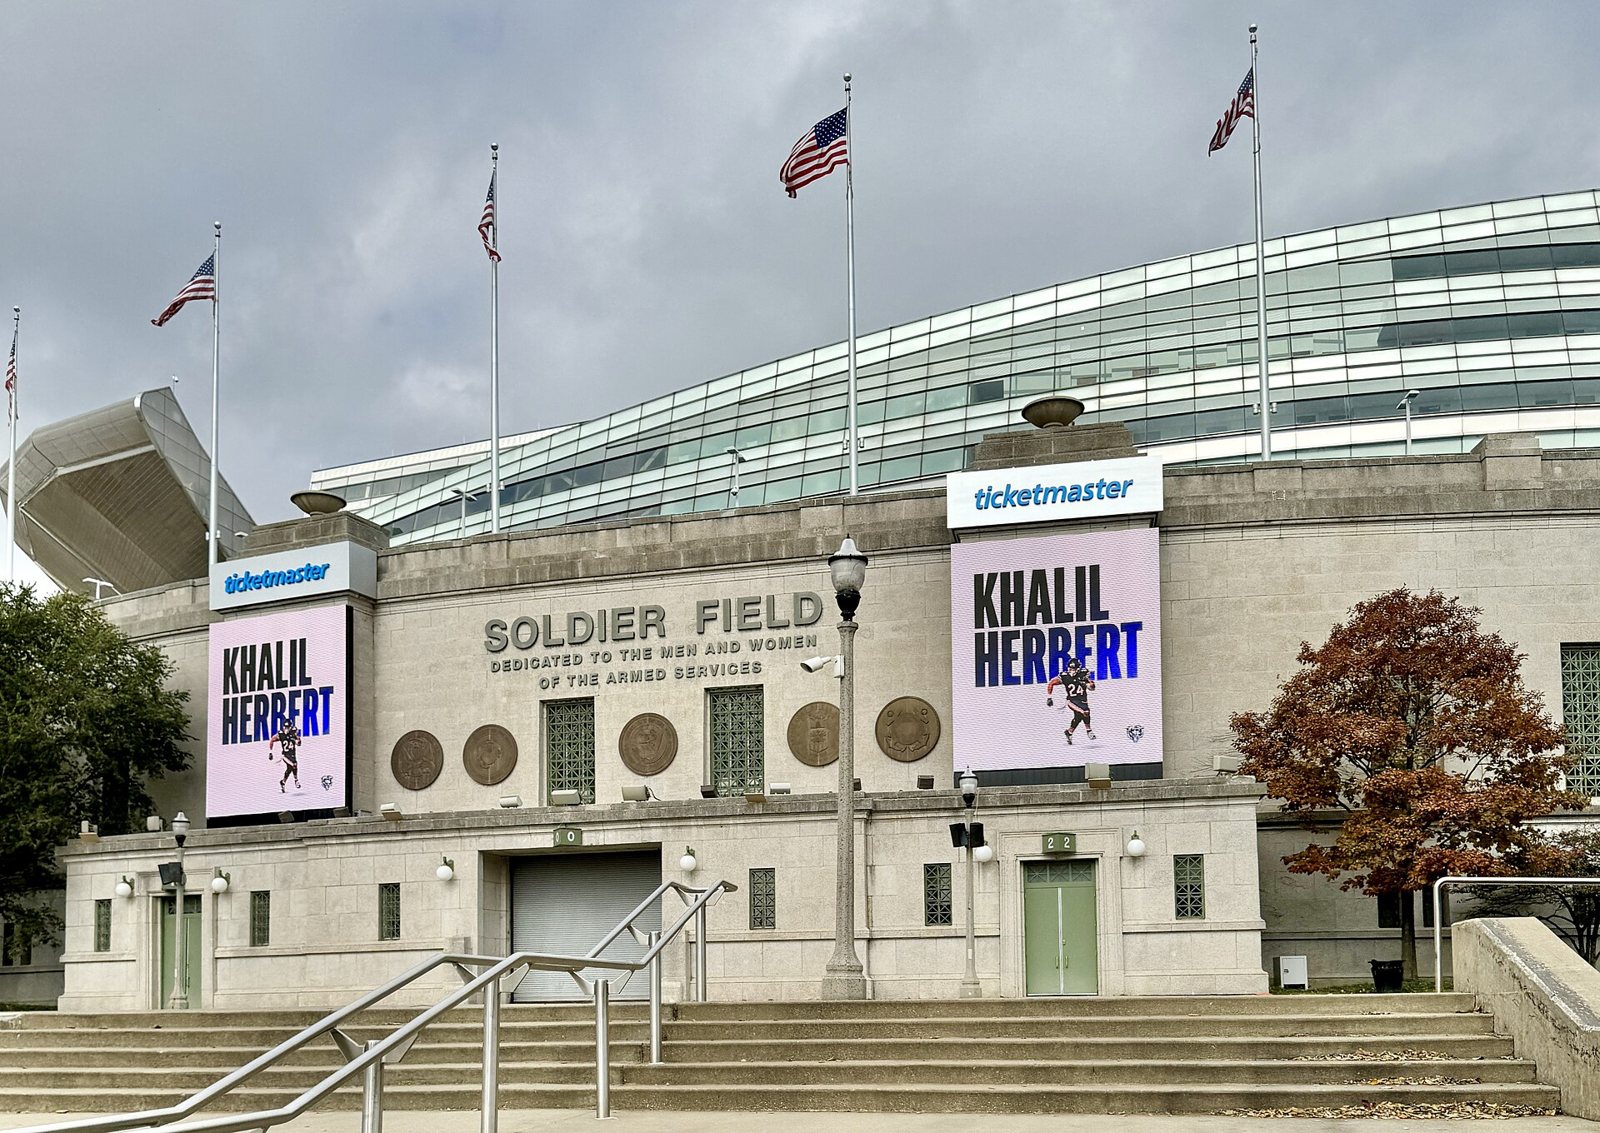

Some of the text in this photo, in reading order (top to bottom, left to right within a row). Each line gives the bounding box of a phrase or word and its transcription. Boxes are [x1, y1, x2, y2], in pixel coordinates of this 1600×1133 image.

[974, 478, 1133, 511] ticketmaster
[224, 562, 330, 594] ticketmaster
[973, 564, 1109, 629] KHALIL
[484, 591, 823, 653] SOLDIER FIELD
[222, 638, 312, 695] KHALIL
[491, 634, 817, 672] DEDICATED TO THE MEN AND WOMEN
[974, 621, 1142, 687] HERBERT
[539, 661, 762, 689] OF THE ARMED SERVICES
[1068, 684, 1084, 697] 24
[222, 686, 334, 745] HERBERT
[283, 740, 294, 752] 24
